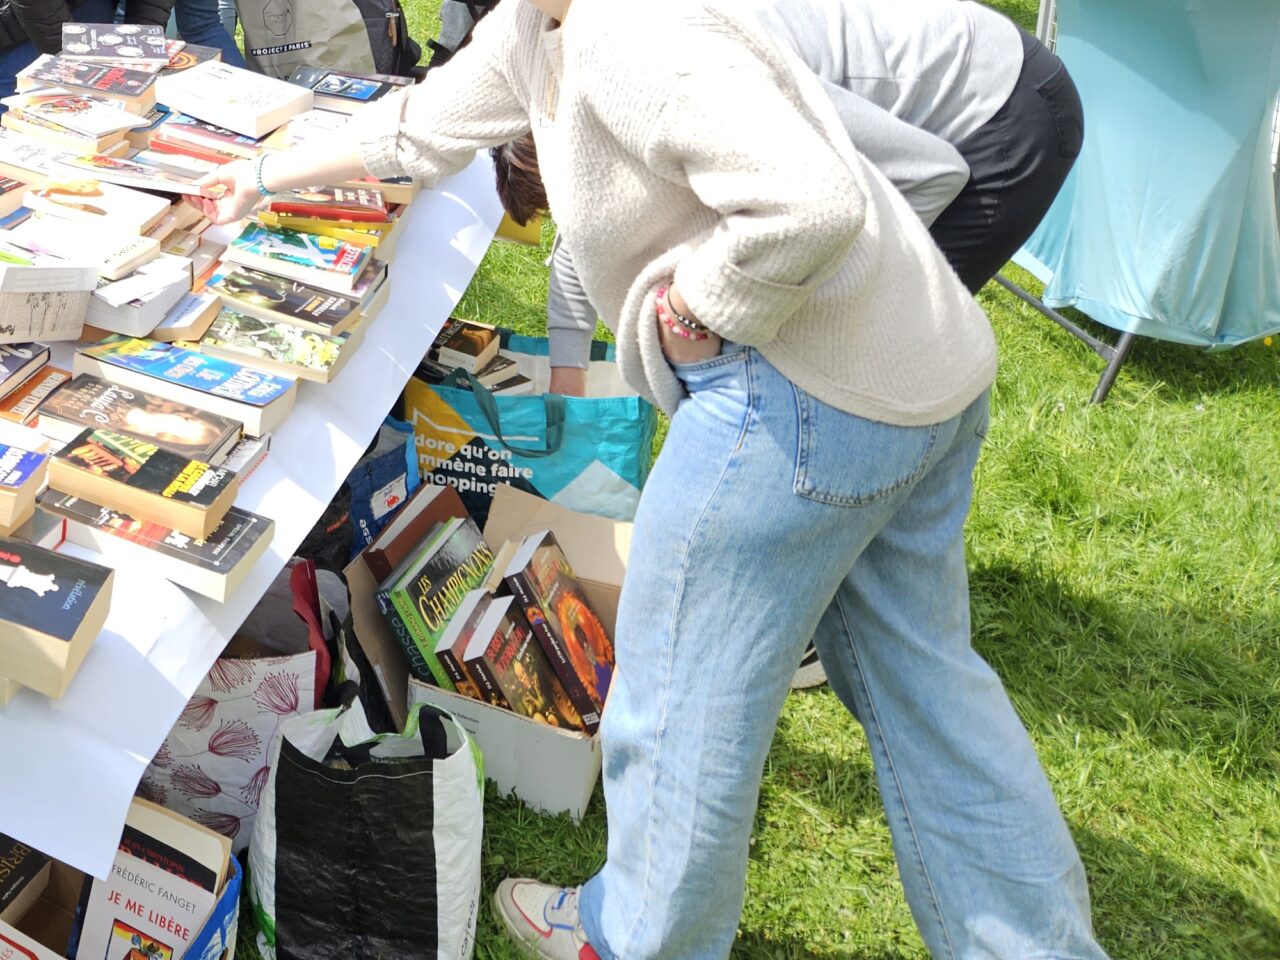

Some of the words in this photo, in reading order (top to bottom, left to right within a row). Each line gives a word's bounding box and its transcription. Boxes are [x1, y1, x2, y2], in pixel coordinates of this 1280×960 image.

[251, 46, 283, 56] PROJECT
[288, 41, 310, 52] PARIS
[84, 382, 139, 415] Laura
[414, 434, 457, 454] dore
[460, 441, 513, 461] qu'on
[490, 463, 534, 479] faire
[59, 577, 88, 612] révélation
[417, 573, 432, 596] LES
[417, 542, 494, 633] CHAMPIGNONS
[406, 614, 425, 641] GRAND
[389, 614, 431, 678] chasse
[124, 838, 186, 873] JEAN-CHRISTOPHE
[111, 864, 155, 893] FRÉDÉRIC
[158, 887, 197, 915] FANGET
[107, 890, 120, 906] JE
[125, 898, 145, 917] ME
[148, 910, 190, 941] LIBÈRE
